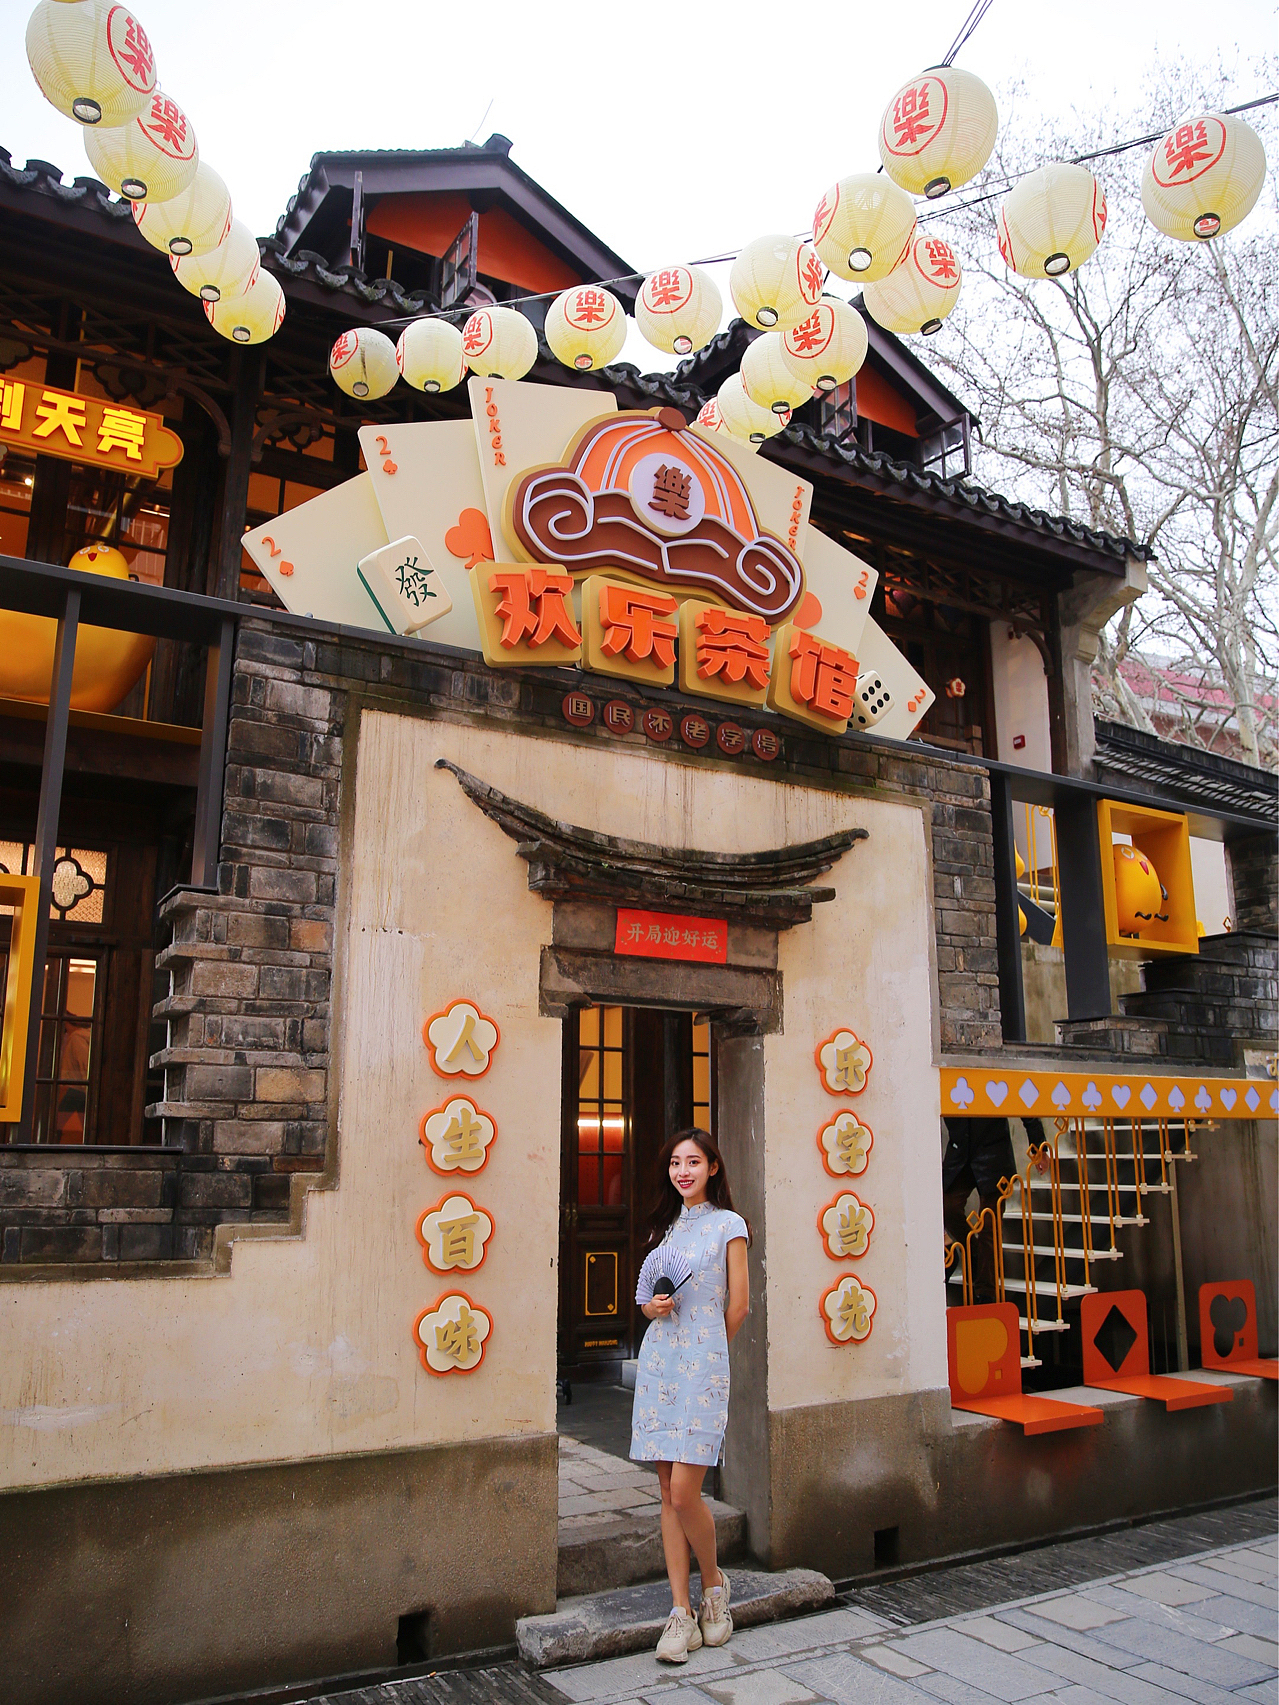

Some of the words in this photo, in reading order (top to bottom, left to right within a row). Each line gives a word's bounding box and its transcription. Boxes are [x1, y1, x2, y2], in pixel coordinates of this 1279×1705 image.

[147, 94, 187, 154] 樂
[893, 82, 936, 147] 樂
[1164, 120, 1214, 179] 樂
[925, 238, 959, 279] 樂
[574, 290, 606, 323] 樂
[650, 267, 684, 308] 樂
[464, 315, 485, 350] 樂
[792, 308, 826, 352] 樂
[375, 435, 392, 456] 2
[647, 463, 692, 521] 樂
[261, 536, 282, 558] 2
[394, 556, 438, 608] 發
[857, 570, 870, 588] 2
[488, 568, 860, 722] 欢乐茶馆
[912, 688, 927, 704] 2
[569, 696, 778, 755] 国民不老字号
[626, 922, 720, 950] 开局迎好运
[434, 1013, 487, 1364] 人生百味
[834, 1039, 871, 1337] 乐字当先
